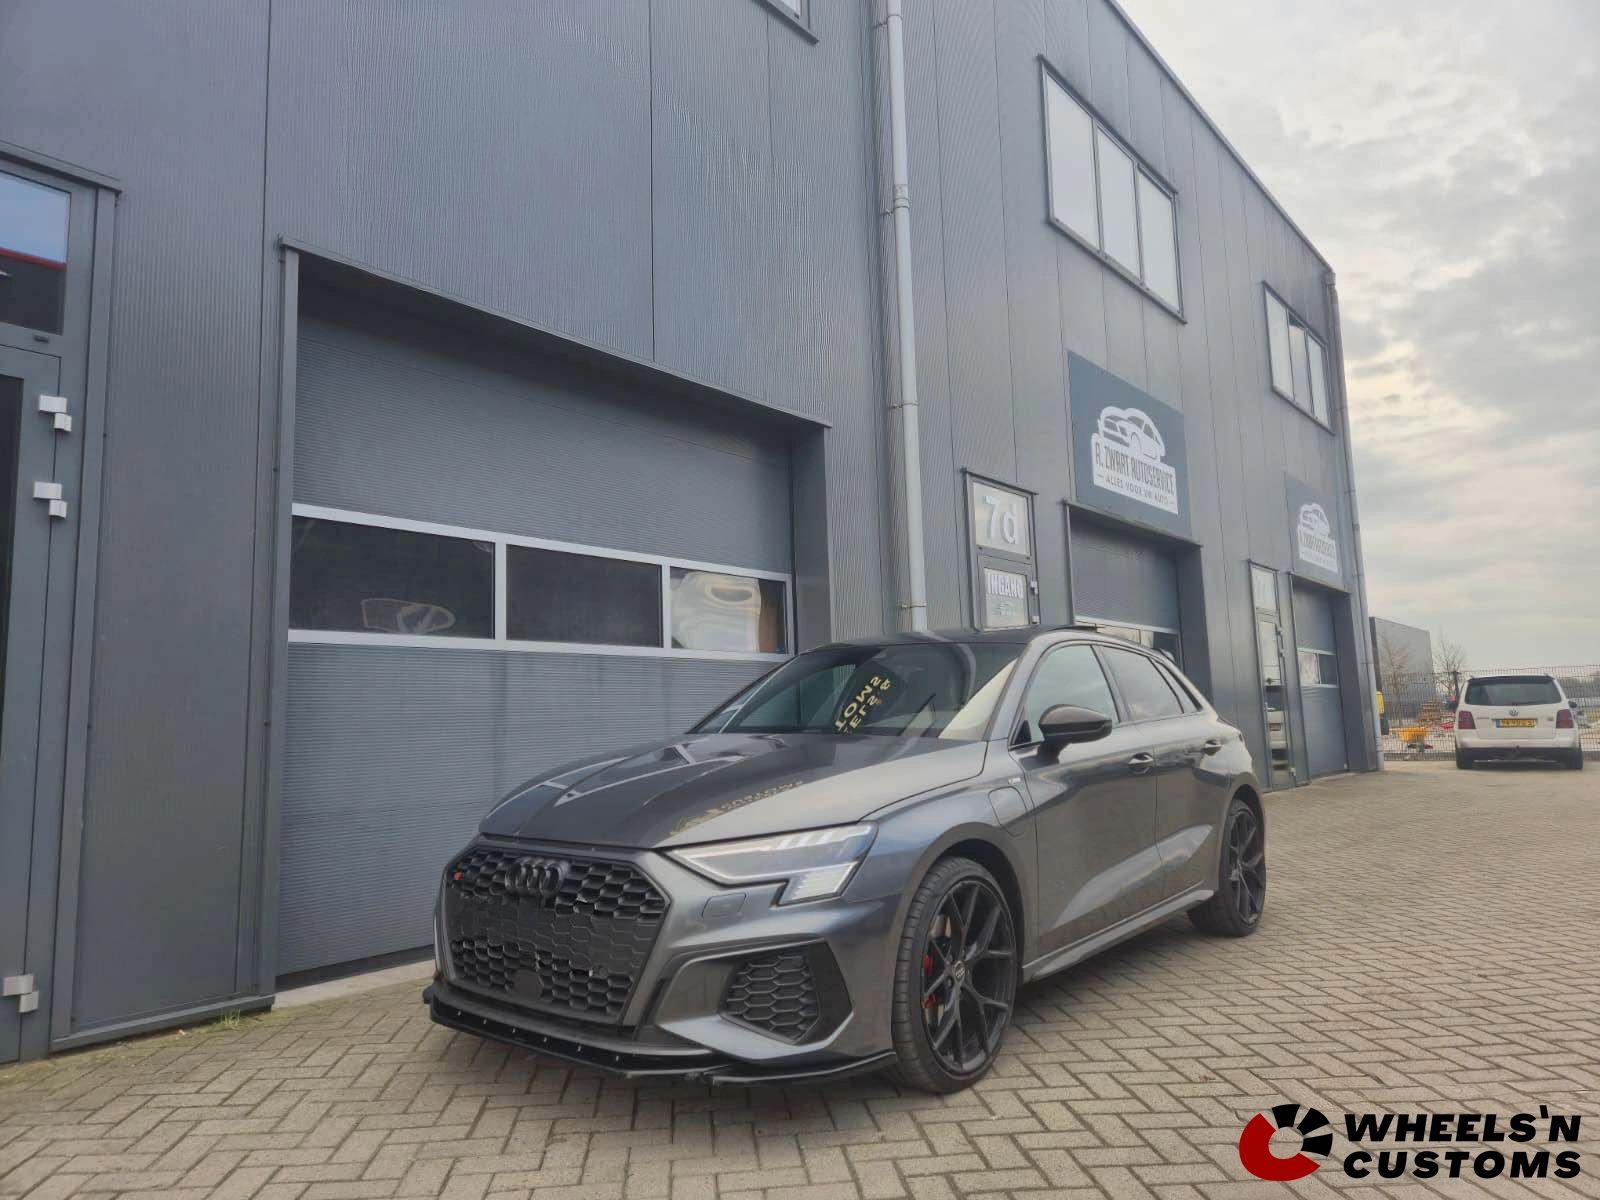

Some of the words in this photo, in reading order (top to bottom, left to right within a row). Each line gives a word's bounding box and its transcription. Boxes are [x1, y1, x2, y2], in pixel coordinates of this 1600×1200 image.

[1104, 446, 1129, 477] ZWART
[1130, 455, 1175, 497] AUTOSERVICE
[987, 572, 1024, 599] INGANG
